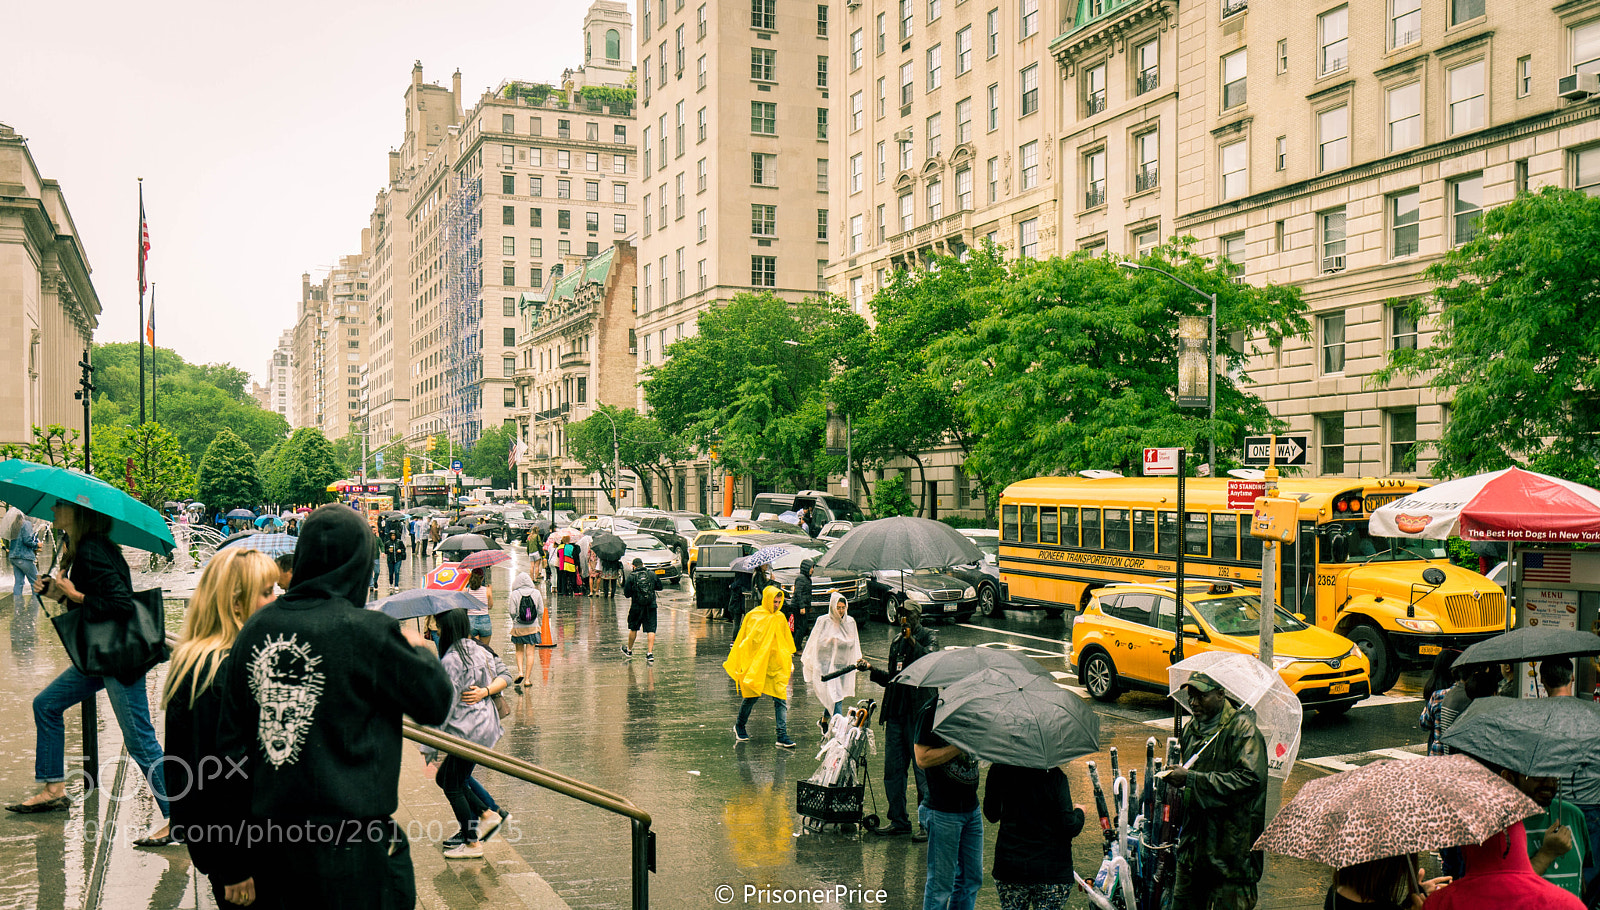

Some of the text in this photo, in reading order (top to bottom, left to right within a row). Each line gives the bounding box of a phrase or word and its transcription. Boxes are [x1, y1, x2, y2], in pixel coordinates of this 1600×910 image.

[1253, 445, 1297, 457] ONE WAY
[1468, 529, 1600, 540] The Best Hot Dogs in New York
[1038, 550, 1145, 569] PIONEER TRANSPORTATION CORP.
[1218, 566, 1230, 577] 2362
[1317, 575, 1336, 586] 2362
[1540, 591, 1563, 599] MENU
